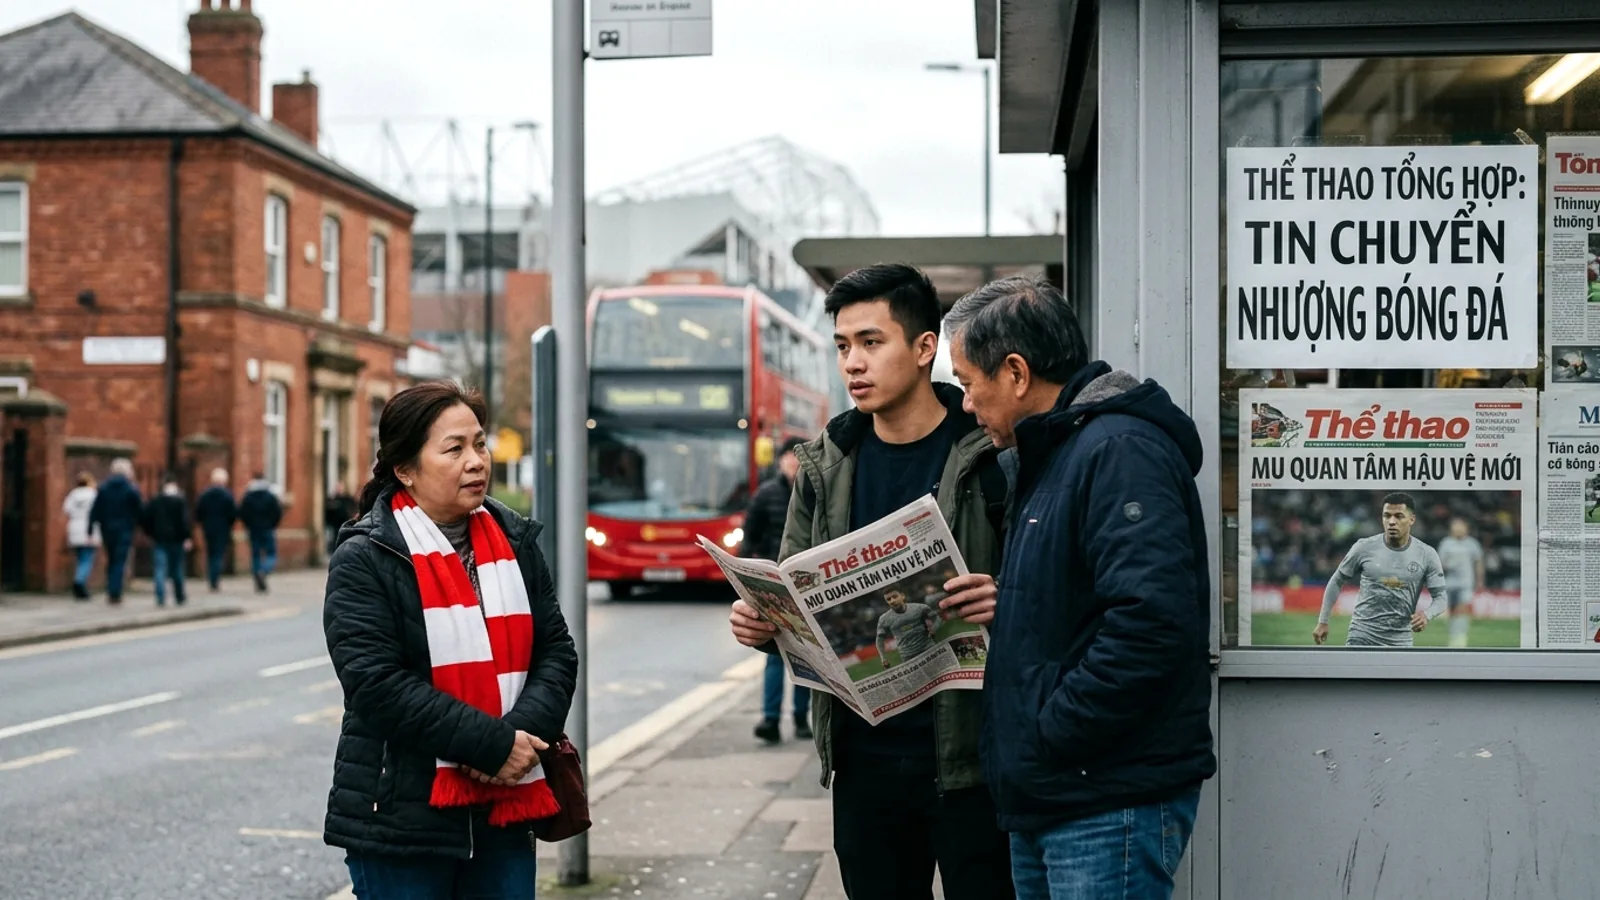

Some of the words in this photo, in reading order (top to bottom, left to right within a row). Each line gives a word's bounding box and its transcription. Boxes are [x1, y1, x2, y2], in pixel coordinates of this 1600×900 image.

[1243, 153, 1296, 200] THỂ
[1302, 166, 1374, 200] THAO
[1381, 152, 1454, 200] TỔNG
[1462, 163, 1526, 207] HỢP:
[1244, 220, 1316, 264] TIN
[1330, 201, 1505, 265] CHUYỂN
[1238, 280, 1367, 353] NHƯỢNG
[1376, 272, 1458, 341] BÓNG
[1466, 272, 1508, 341] ĐÁ
[1304, 404, 1381, 440] Thể
[1383, 409, 1470, 440] thao
[1251, 457, 1284, 480] MU
[1290, 456, 1348, 483] QUAN
[1353, 452, 1396, 480] TÂM
[1402, 452, 1445, 486] HẬU
[1450, 453, 1476, 486] VỆ
[1481, 453, 1522, 480] MỚI
[803, 592, 824, 610] MU
[824, 580, 858, 602] QUAN
[856, 570, 883, 590] TÂM
